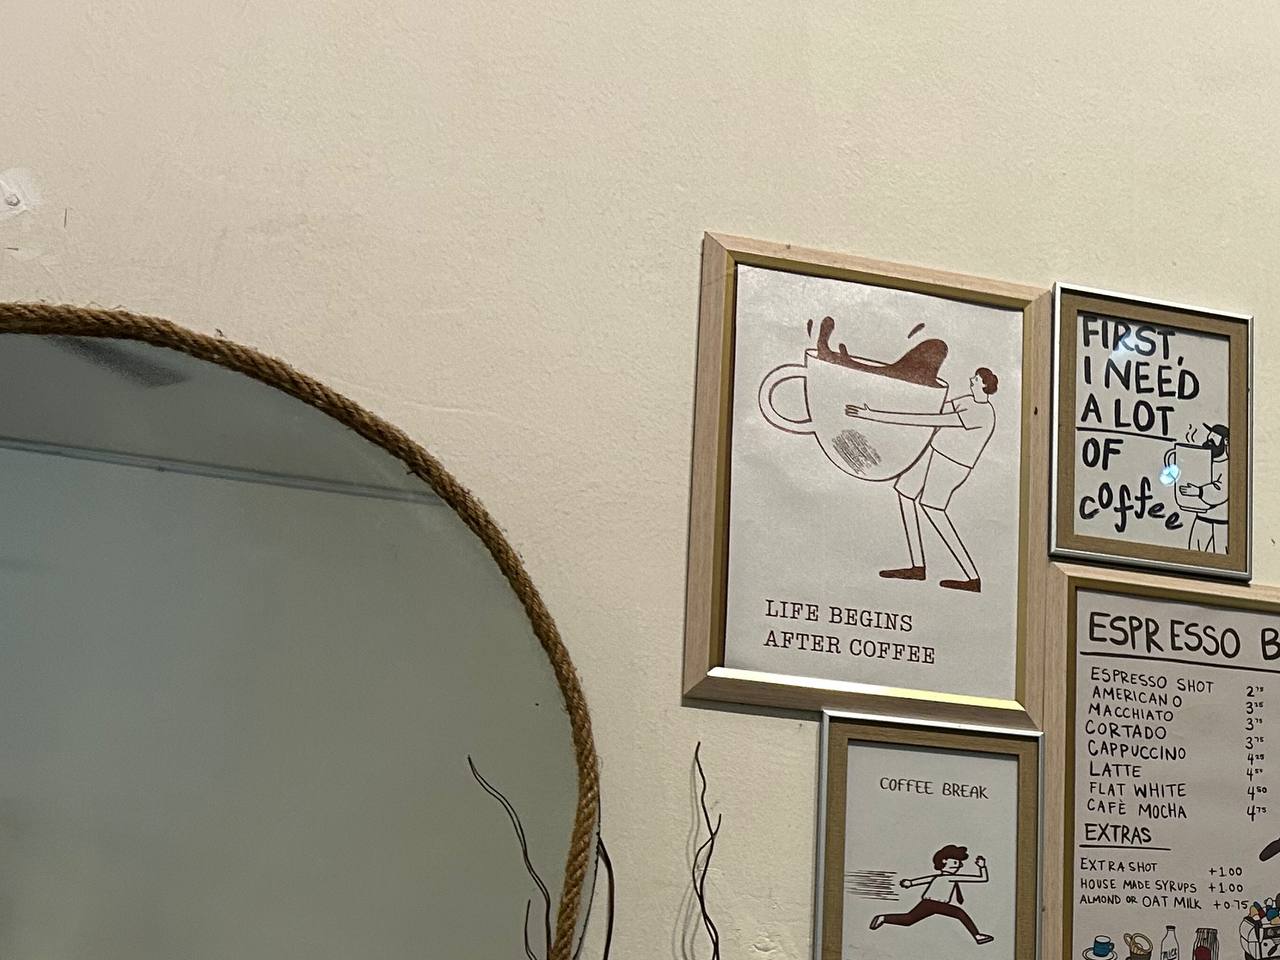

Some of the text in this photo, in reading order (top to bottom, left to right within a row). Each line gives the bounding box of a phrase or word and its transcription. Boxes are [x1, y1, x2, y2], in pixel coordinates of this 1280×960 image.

[1084, 356, 1200, 400] I NEED
[1080, 393, 1175, 436] A LOT
[1082, 437, 1124, 471] OF
[1079, 476, 1183, 533] coffee
[765, 600, 913, 632] LIFE BEGINS
[1089, 611, 1241, 659] ESPRESSO
[763, 631, 935, 664] AFTER COFFEE
[1091, 667, 1167, 689] ESPRESSO
[1177, 678, 1214, 694] SHOT
[1092, 685, 1182, 708] AMERICANO
[1088, 703, 1174, 722] MACCHIATO
[1085, 720, 1167, 740] CORTADO
[1087, 740, 1187, 761] CAPPUCCINO
[1089, 761, 1142, 778] LATTE
[879, 777, 989, 800] COFFEE BREAK
[1089, 782, 1126, 797] FLAT
[1134, 782, 1187, 798] WHITE
[1138, 802, 1188, 820] MOCHA
[1084, 823, 1152, 845] EXTRAS
[1080, 878, 1117, 890] HOUSE
[1122, 879, 1151, 891] MADE
[1155, 880, 1197, 894] SYRUPS
[1079, 893, 1122, 905] ALMOND
[1125, 894, 1138, 905] OR
[1142, 895, 1168, 908] OAT
